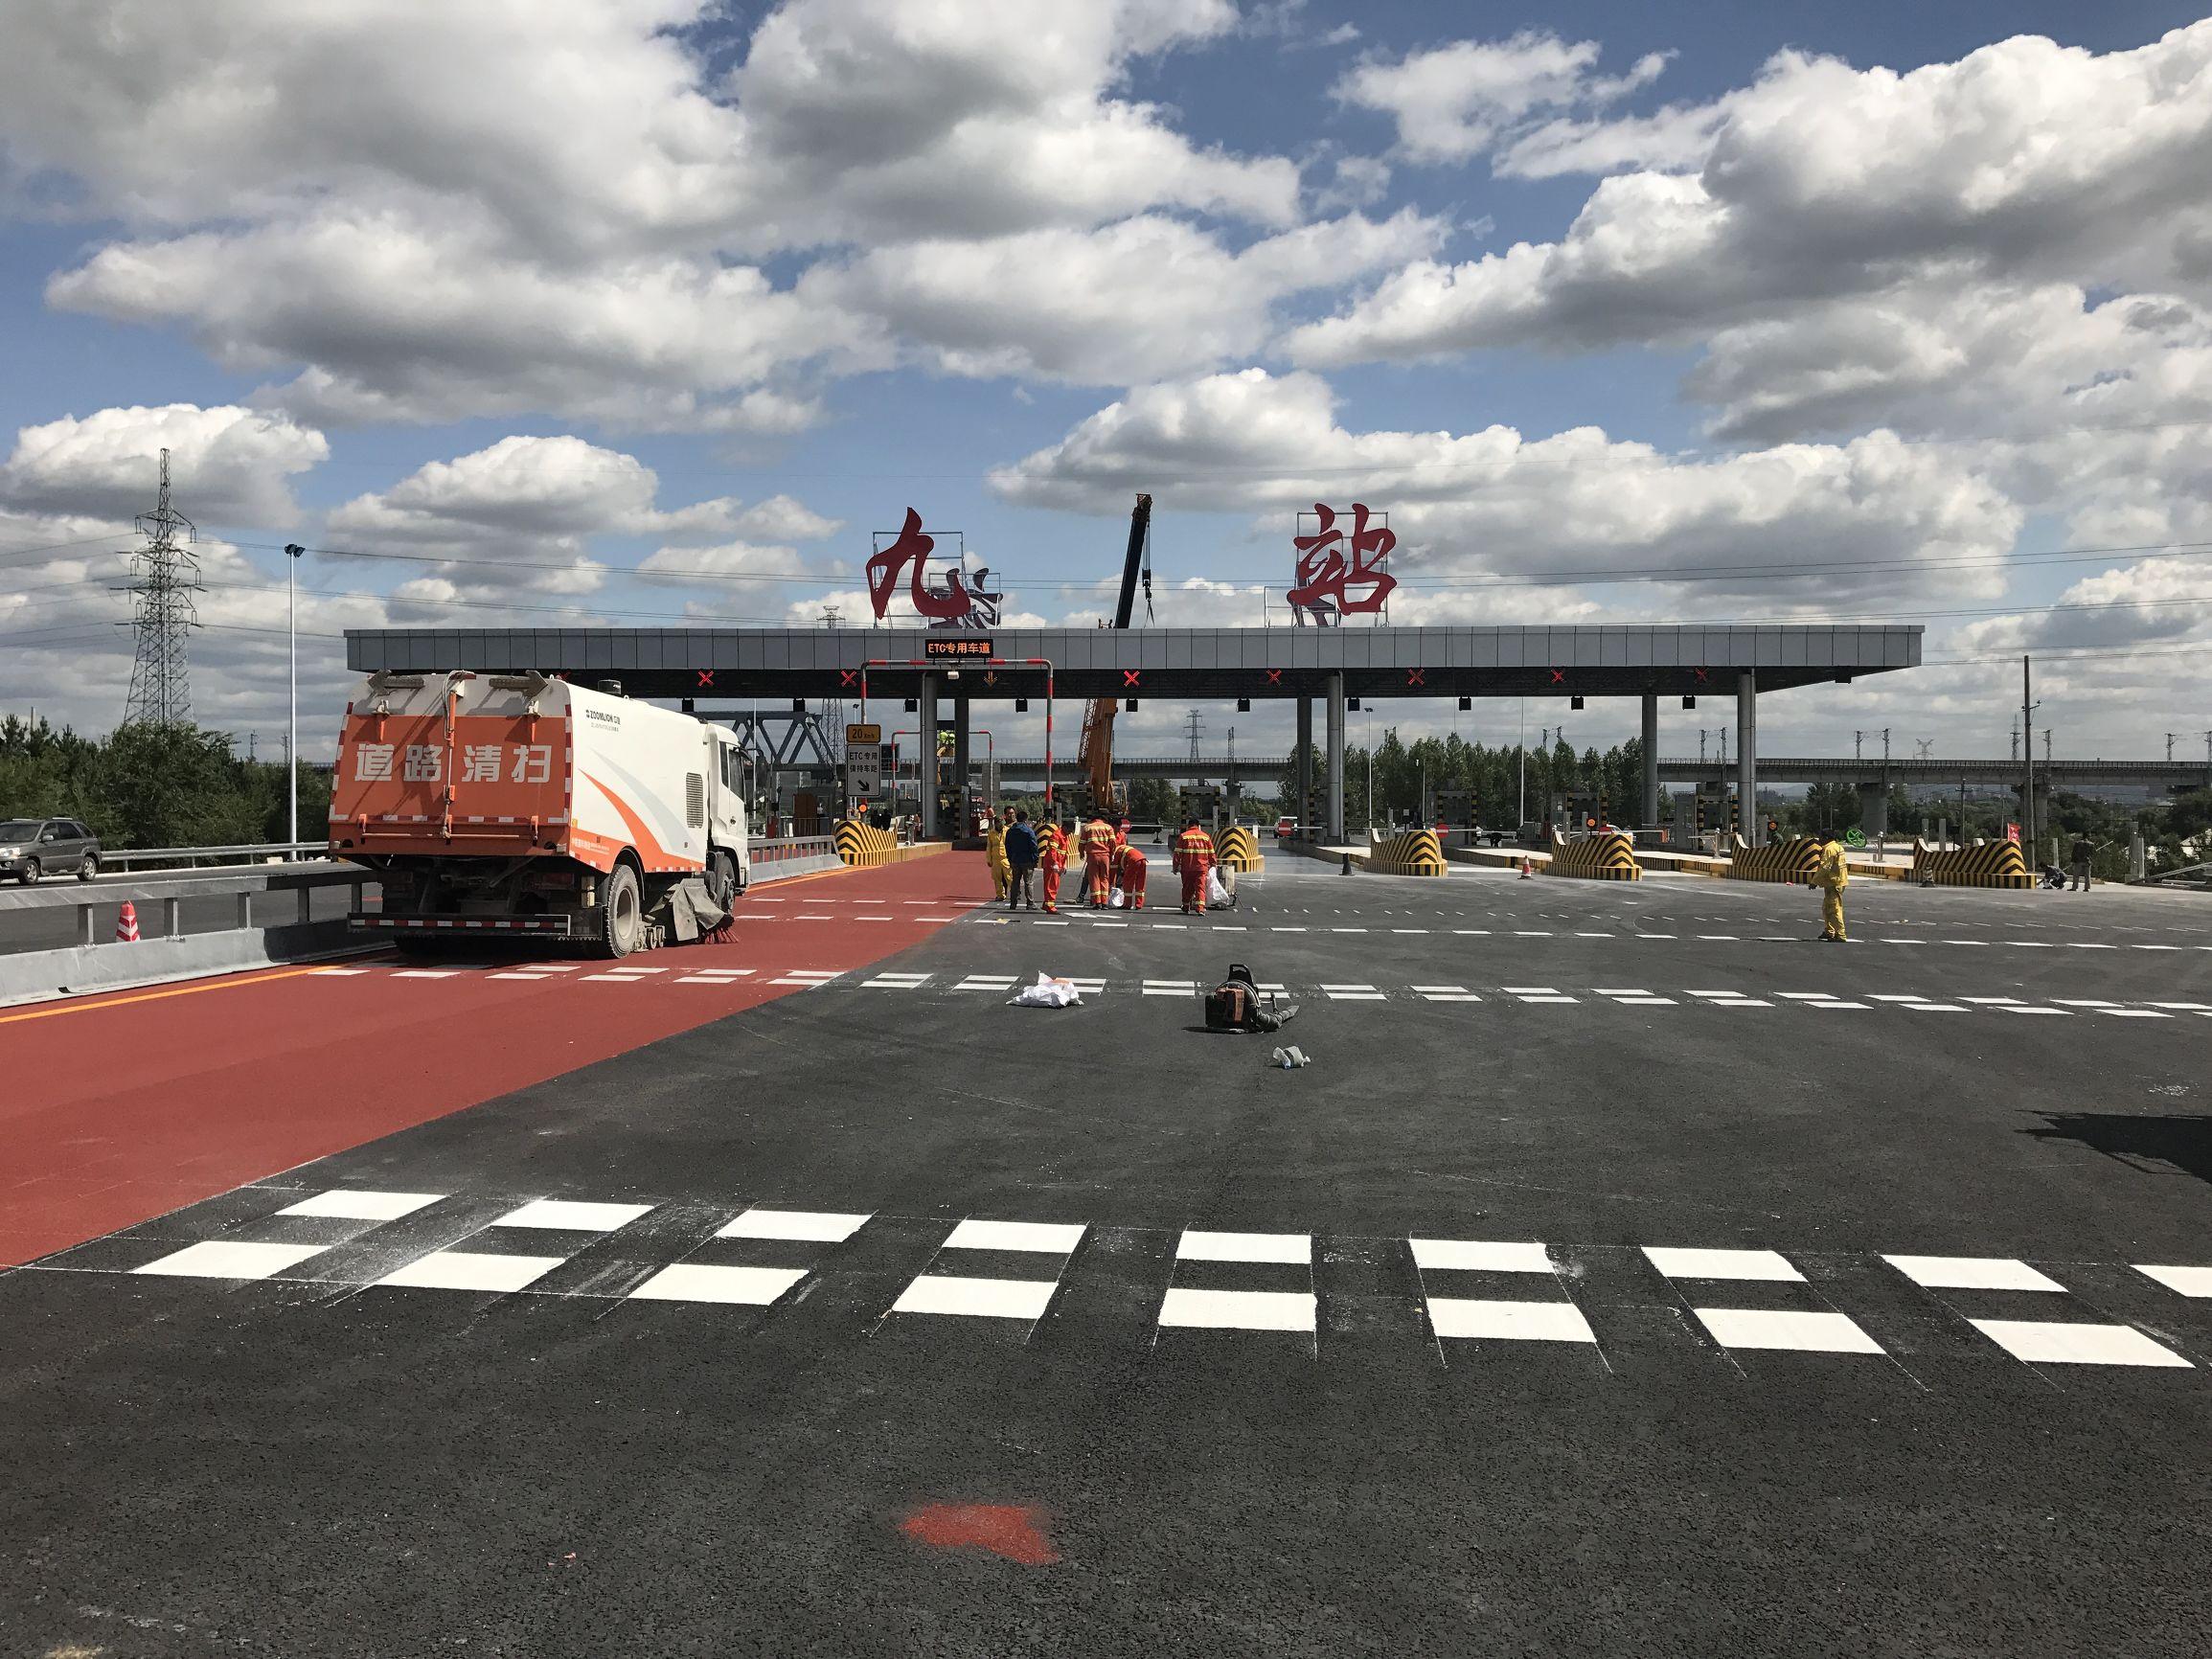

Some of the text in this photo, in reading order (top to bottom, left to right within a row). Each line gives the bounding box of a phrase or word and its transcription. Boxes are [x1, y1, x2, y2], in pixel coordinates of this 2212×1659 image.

[865, 507, 971, 621] 九
[1287, 503, 1398, 616] 站
[927, 642, 991, 654] ETC专用车道
[852, 728, 863, 739] 20
[354, 743, 553, 784] 道路清扫
